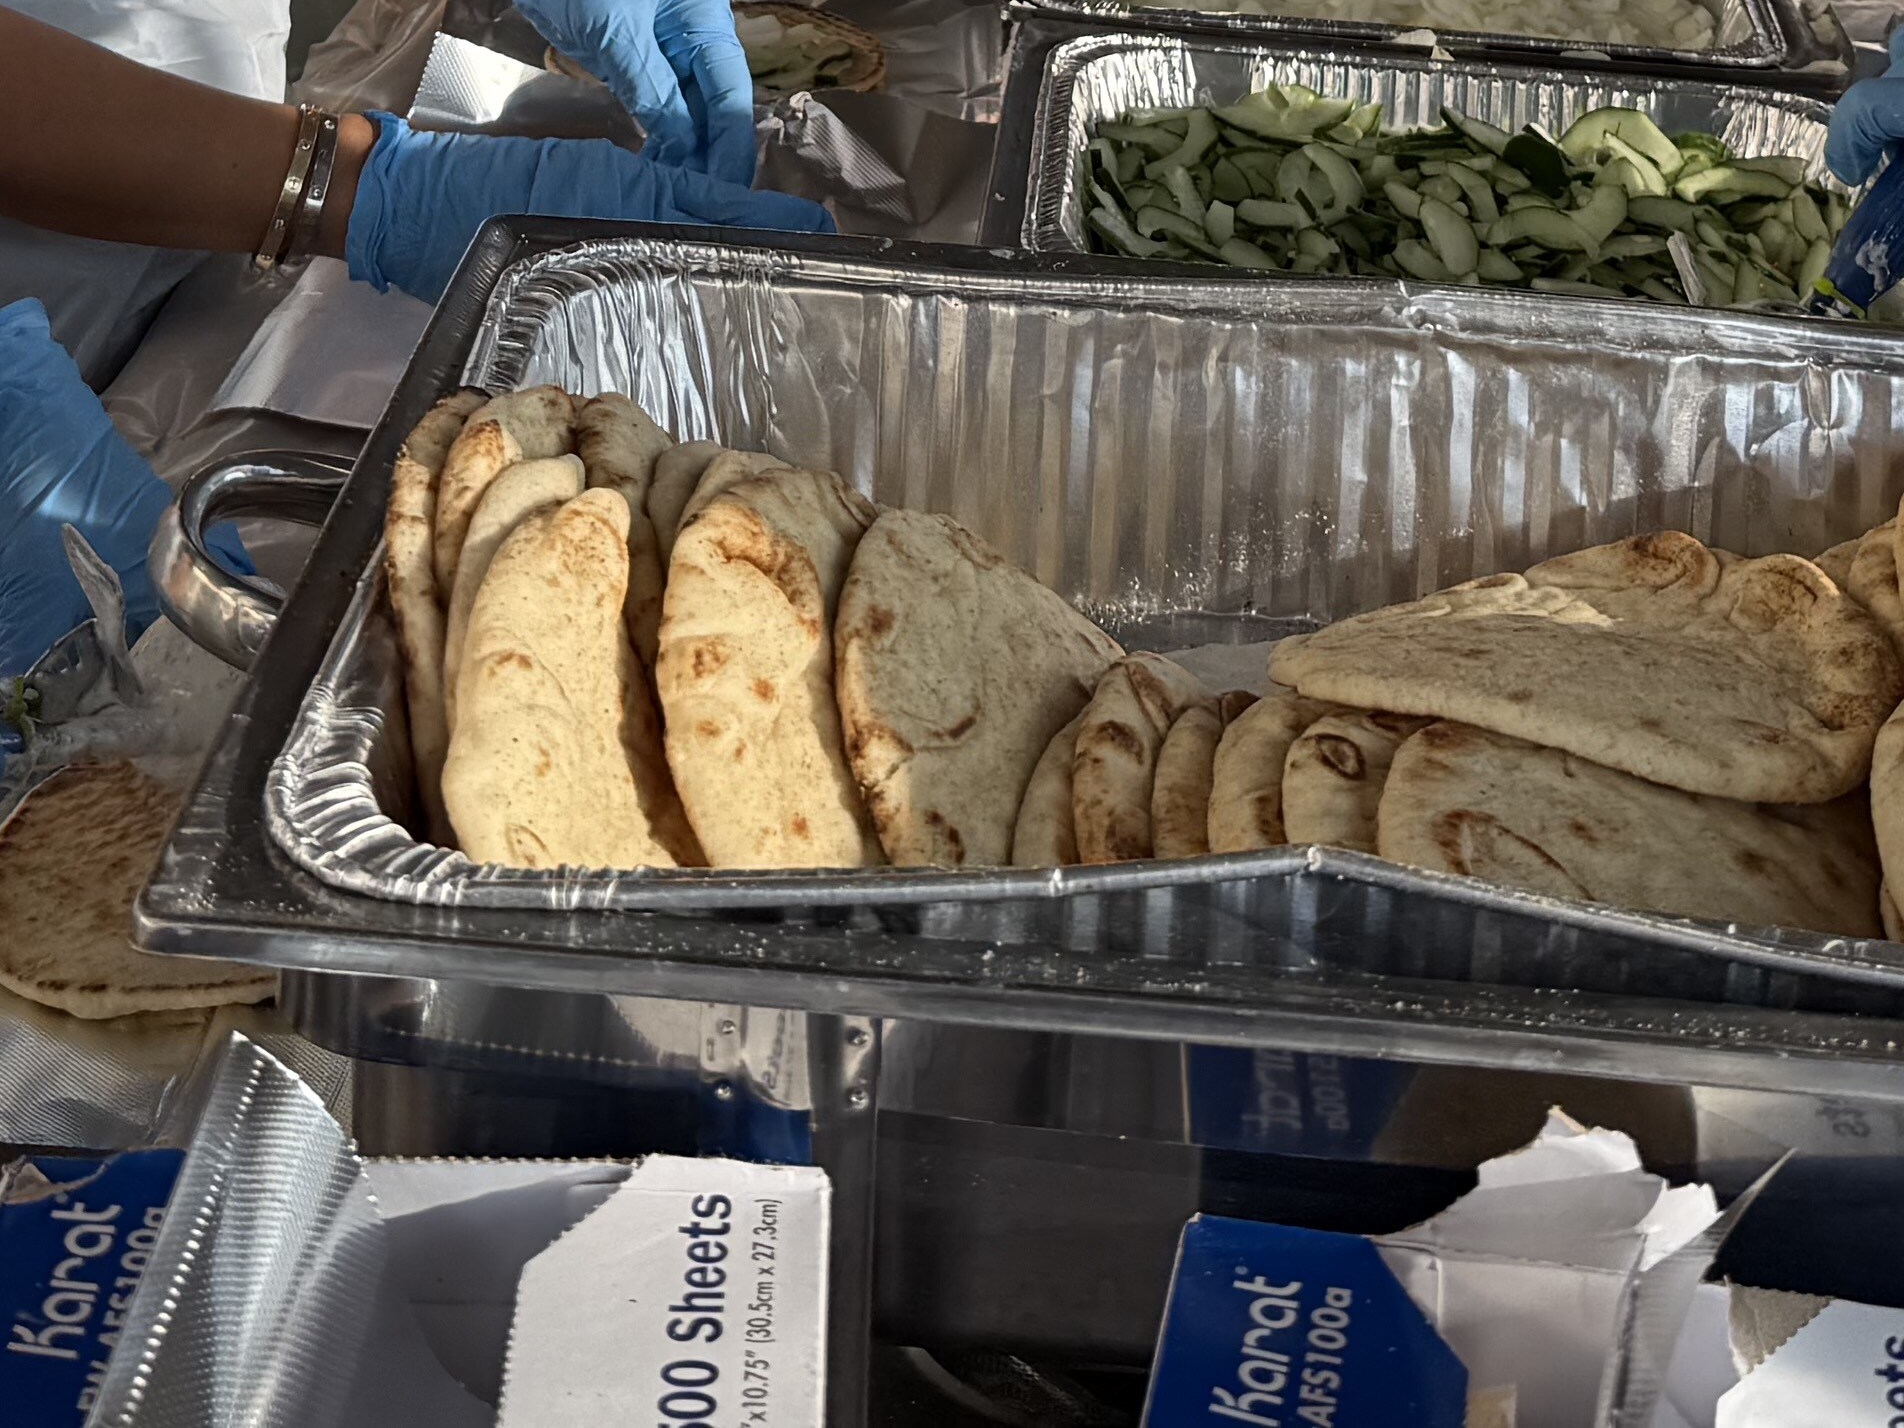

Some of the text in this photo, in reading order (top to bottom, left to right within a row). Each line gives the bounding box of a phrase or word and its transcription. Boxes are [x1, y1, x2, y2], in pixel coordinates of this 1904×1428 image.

[6, 1201, 123, 1361] Karat
[657, 1194, 732, 1428] 00 Sheets
[1207, 1275, 1304, 1428] Karat
